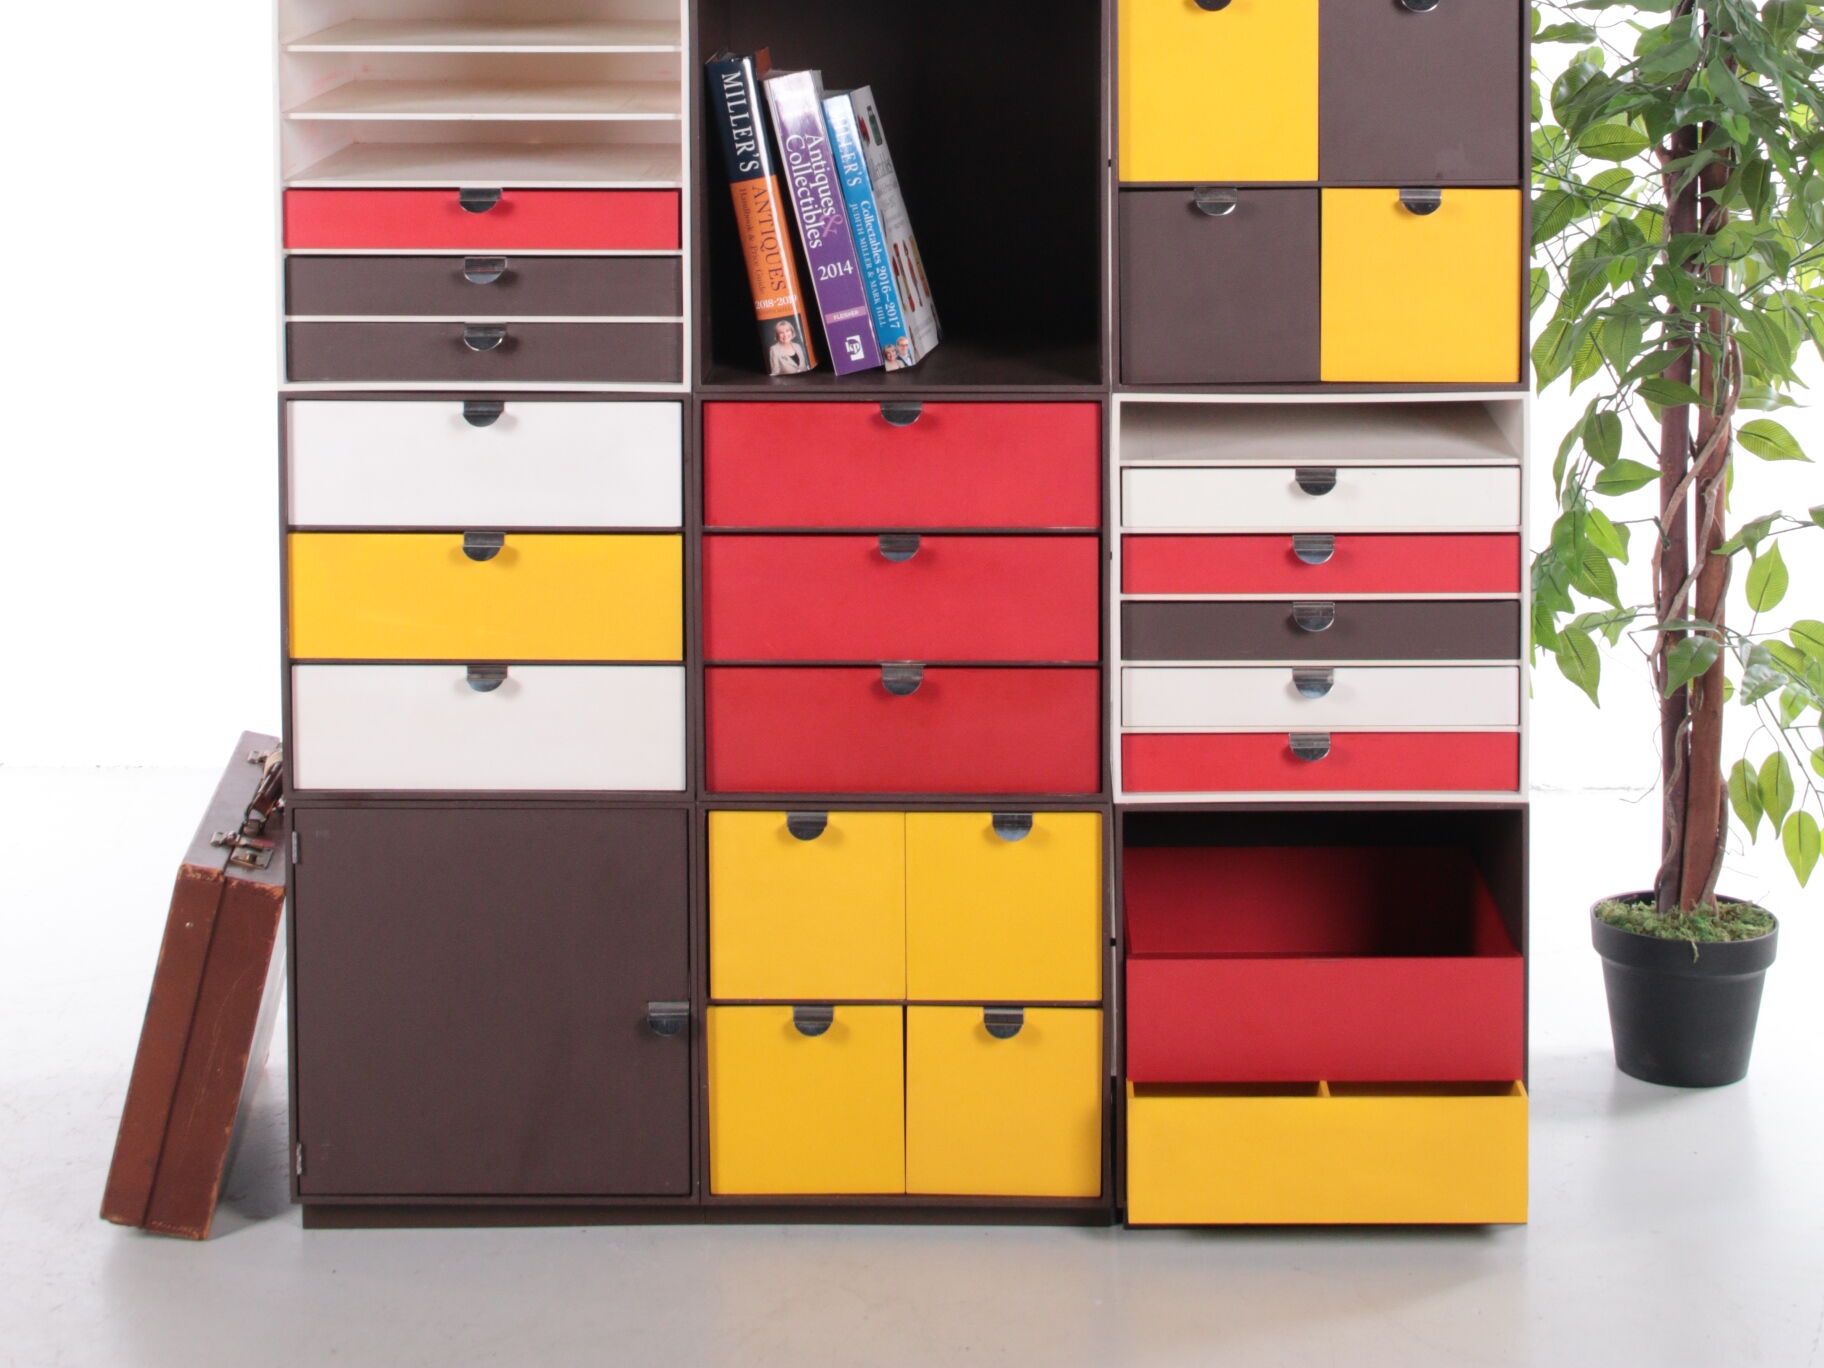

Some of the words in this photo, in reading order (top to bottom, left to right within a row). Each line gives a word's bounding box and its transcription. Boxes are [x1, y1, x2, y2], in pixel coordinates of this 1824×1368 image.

[722, 70, 760, 172] MILLER'S
[786, 134, 825, 249] Collectibles
[805, 134, 836, 217] Antiques
[819, 214, 843, 238] &
[849, 202, 865, 236] JUDITH
[860, 200, 882, 264] Collectables
[752, 186, 787, 291] ANTIQUES
[860, 237, 872, 269] MILLER
[817, 259, 854, 281] 2014
[867, 270, 875, 279] &
[870, 279, 881, 305] MARK
[876, 306, 887, 328] HILL
